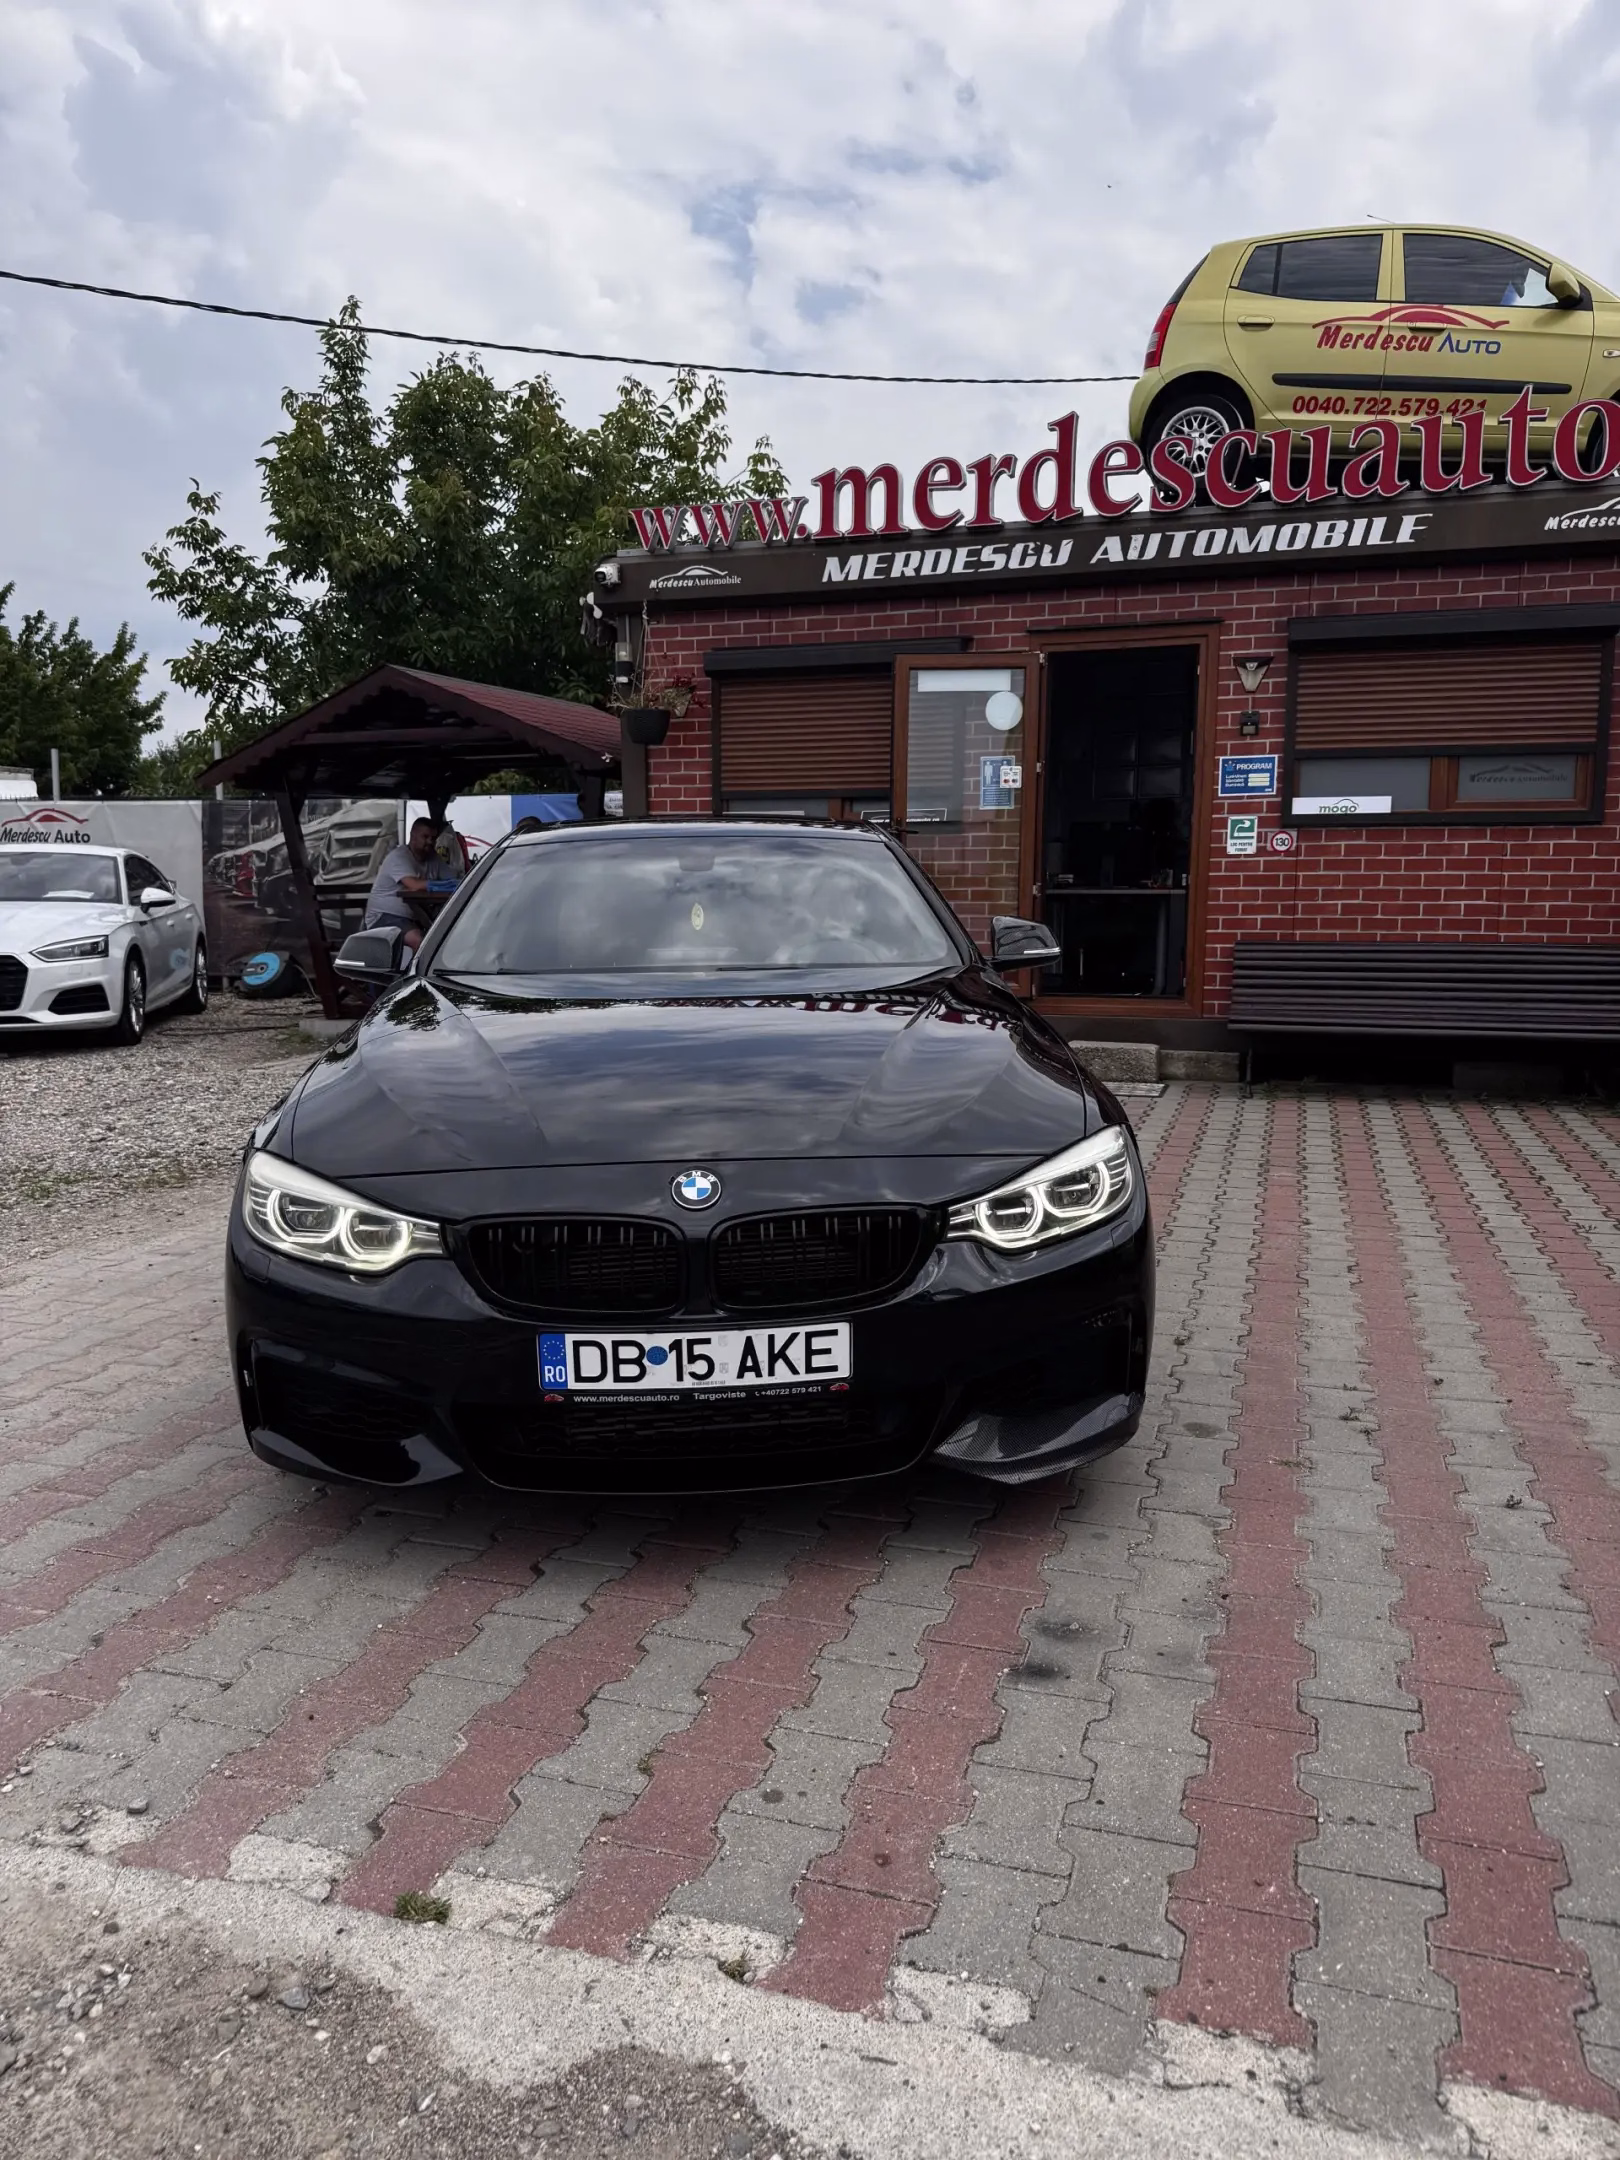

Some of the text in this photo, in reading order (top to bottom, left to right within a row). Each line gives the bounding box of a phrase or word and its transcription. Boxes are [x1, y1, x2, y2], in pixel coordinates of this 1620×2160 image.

[1316, 325, 1434, 352] Merdescu
[1292, 395, 1488, 416] 0040.722.579.421
[630, 383, 1620, 553] www.merdescuauto
[1544, 514, 1620, 531] Merdesc
[821, 513, 1433, 583] MERDESCU AUTOMOBILE
[1236, 762, 1273, 770] PROGRAM
[0, 827, 91, 844] Merdescu Auto
[1275, 837, 1290, 847] 130
[572, 1328, 839, 1384] DB 15 AKE
[544, 1366, 565, 1382] RO
[573, 1394, 680, 1403] www.merdescuauto.ro
[692, 1391, 746, 1400] Targoviste
